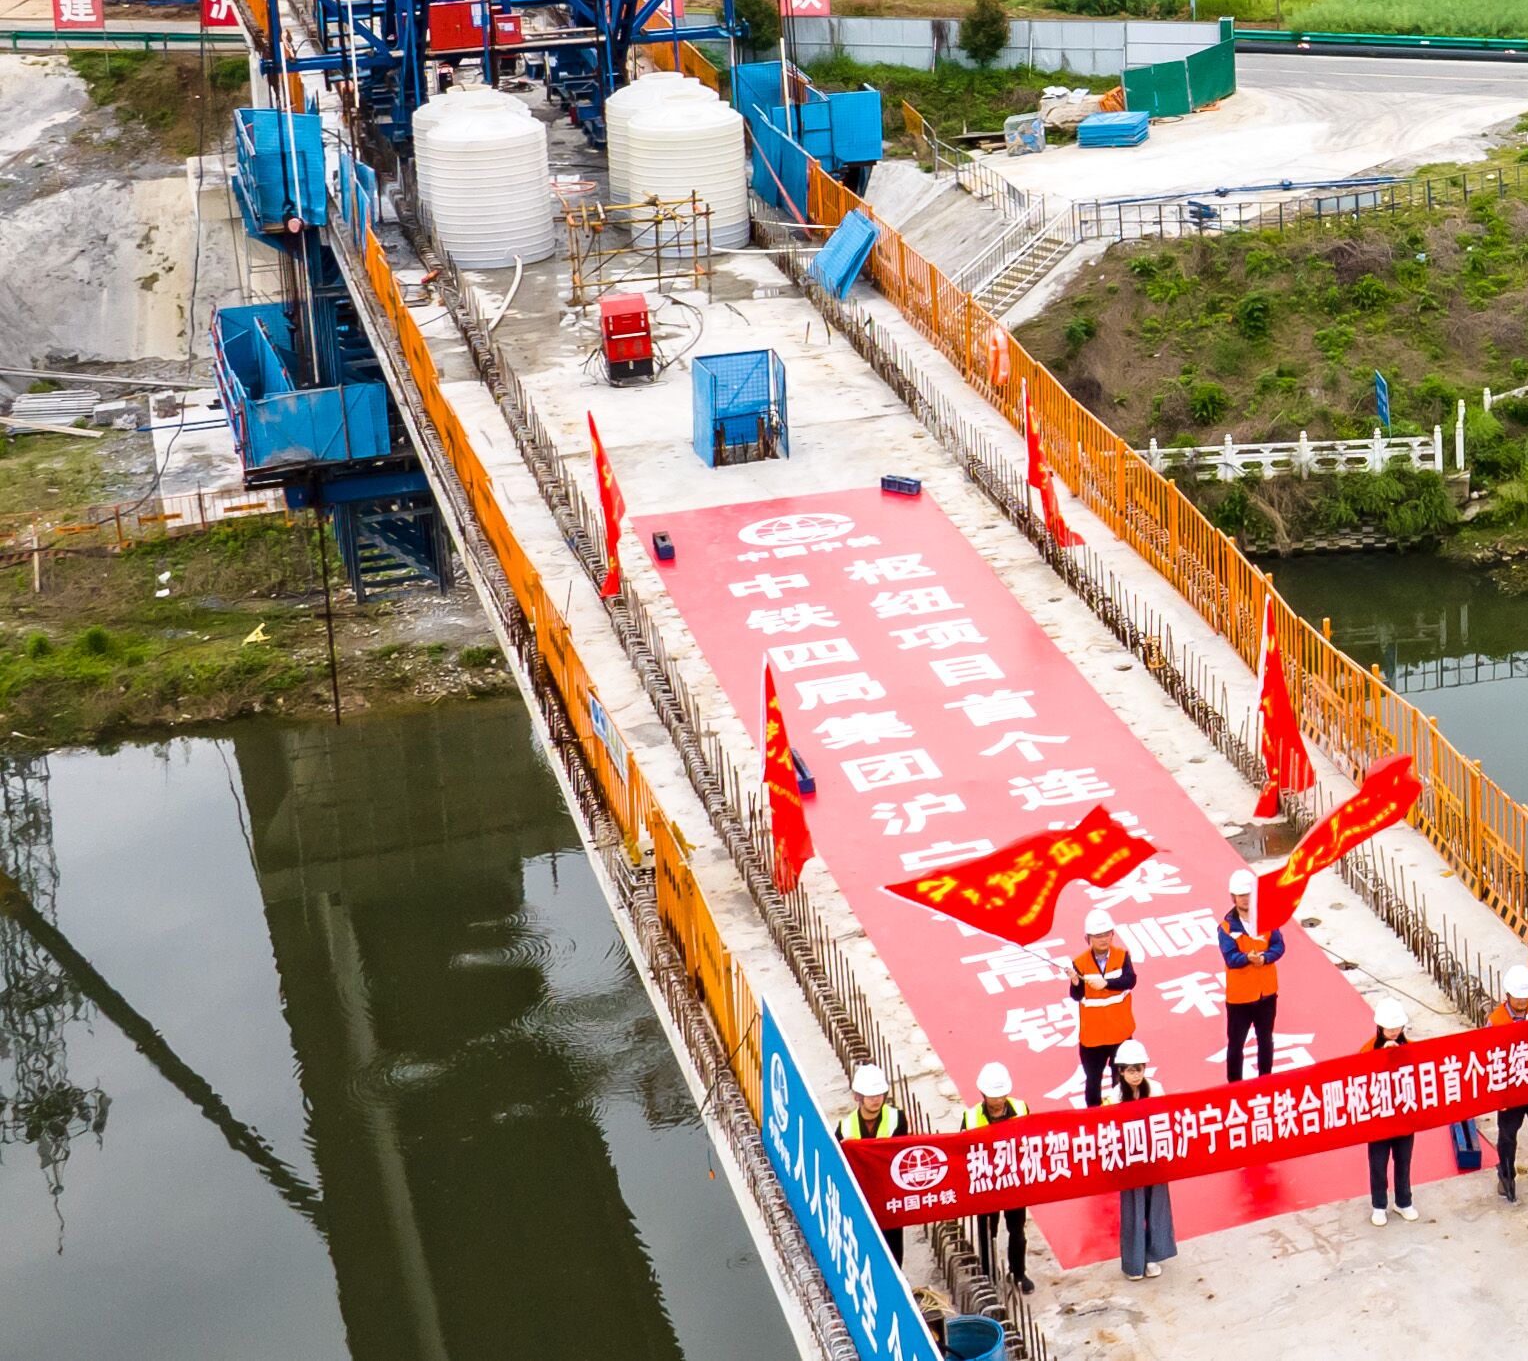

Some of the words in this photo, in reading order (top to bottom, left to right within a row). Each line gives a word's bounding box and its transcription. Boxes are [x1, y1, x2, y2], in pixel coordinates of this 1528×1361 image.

[794, 1114, 878, 1353] 人人讲安全
[886, 1189, 957, 1213] 中国中铁
